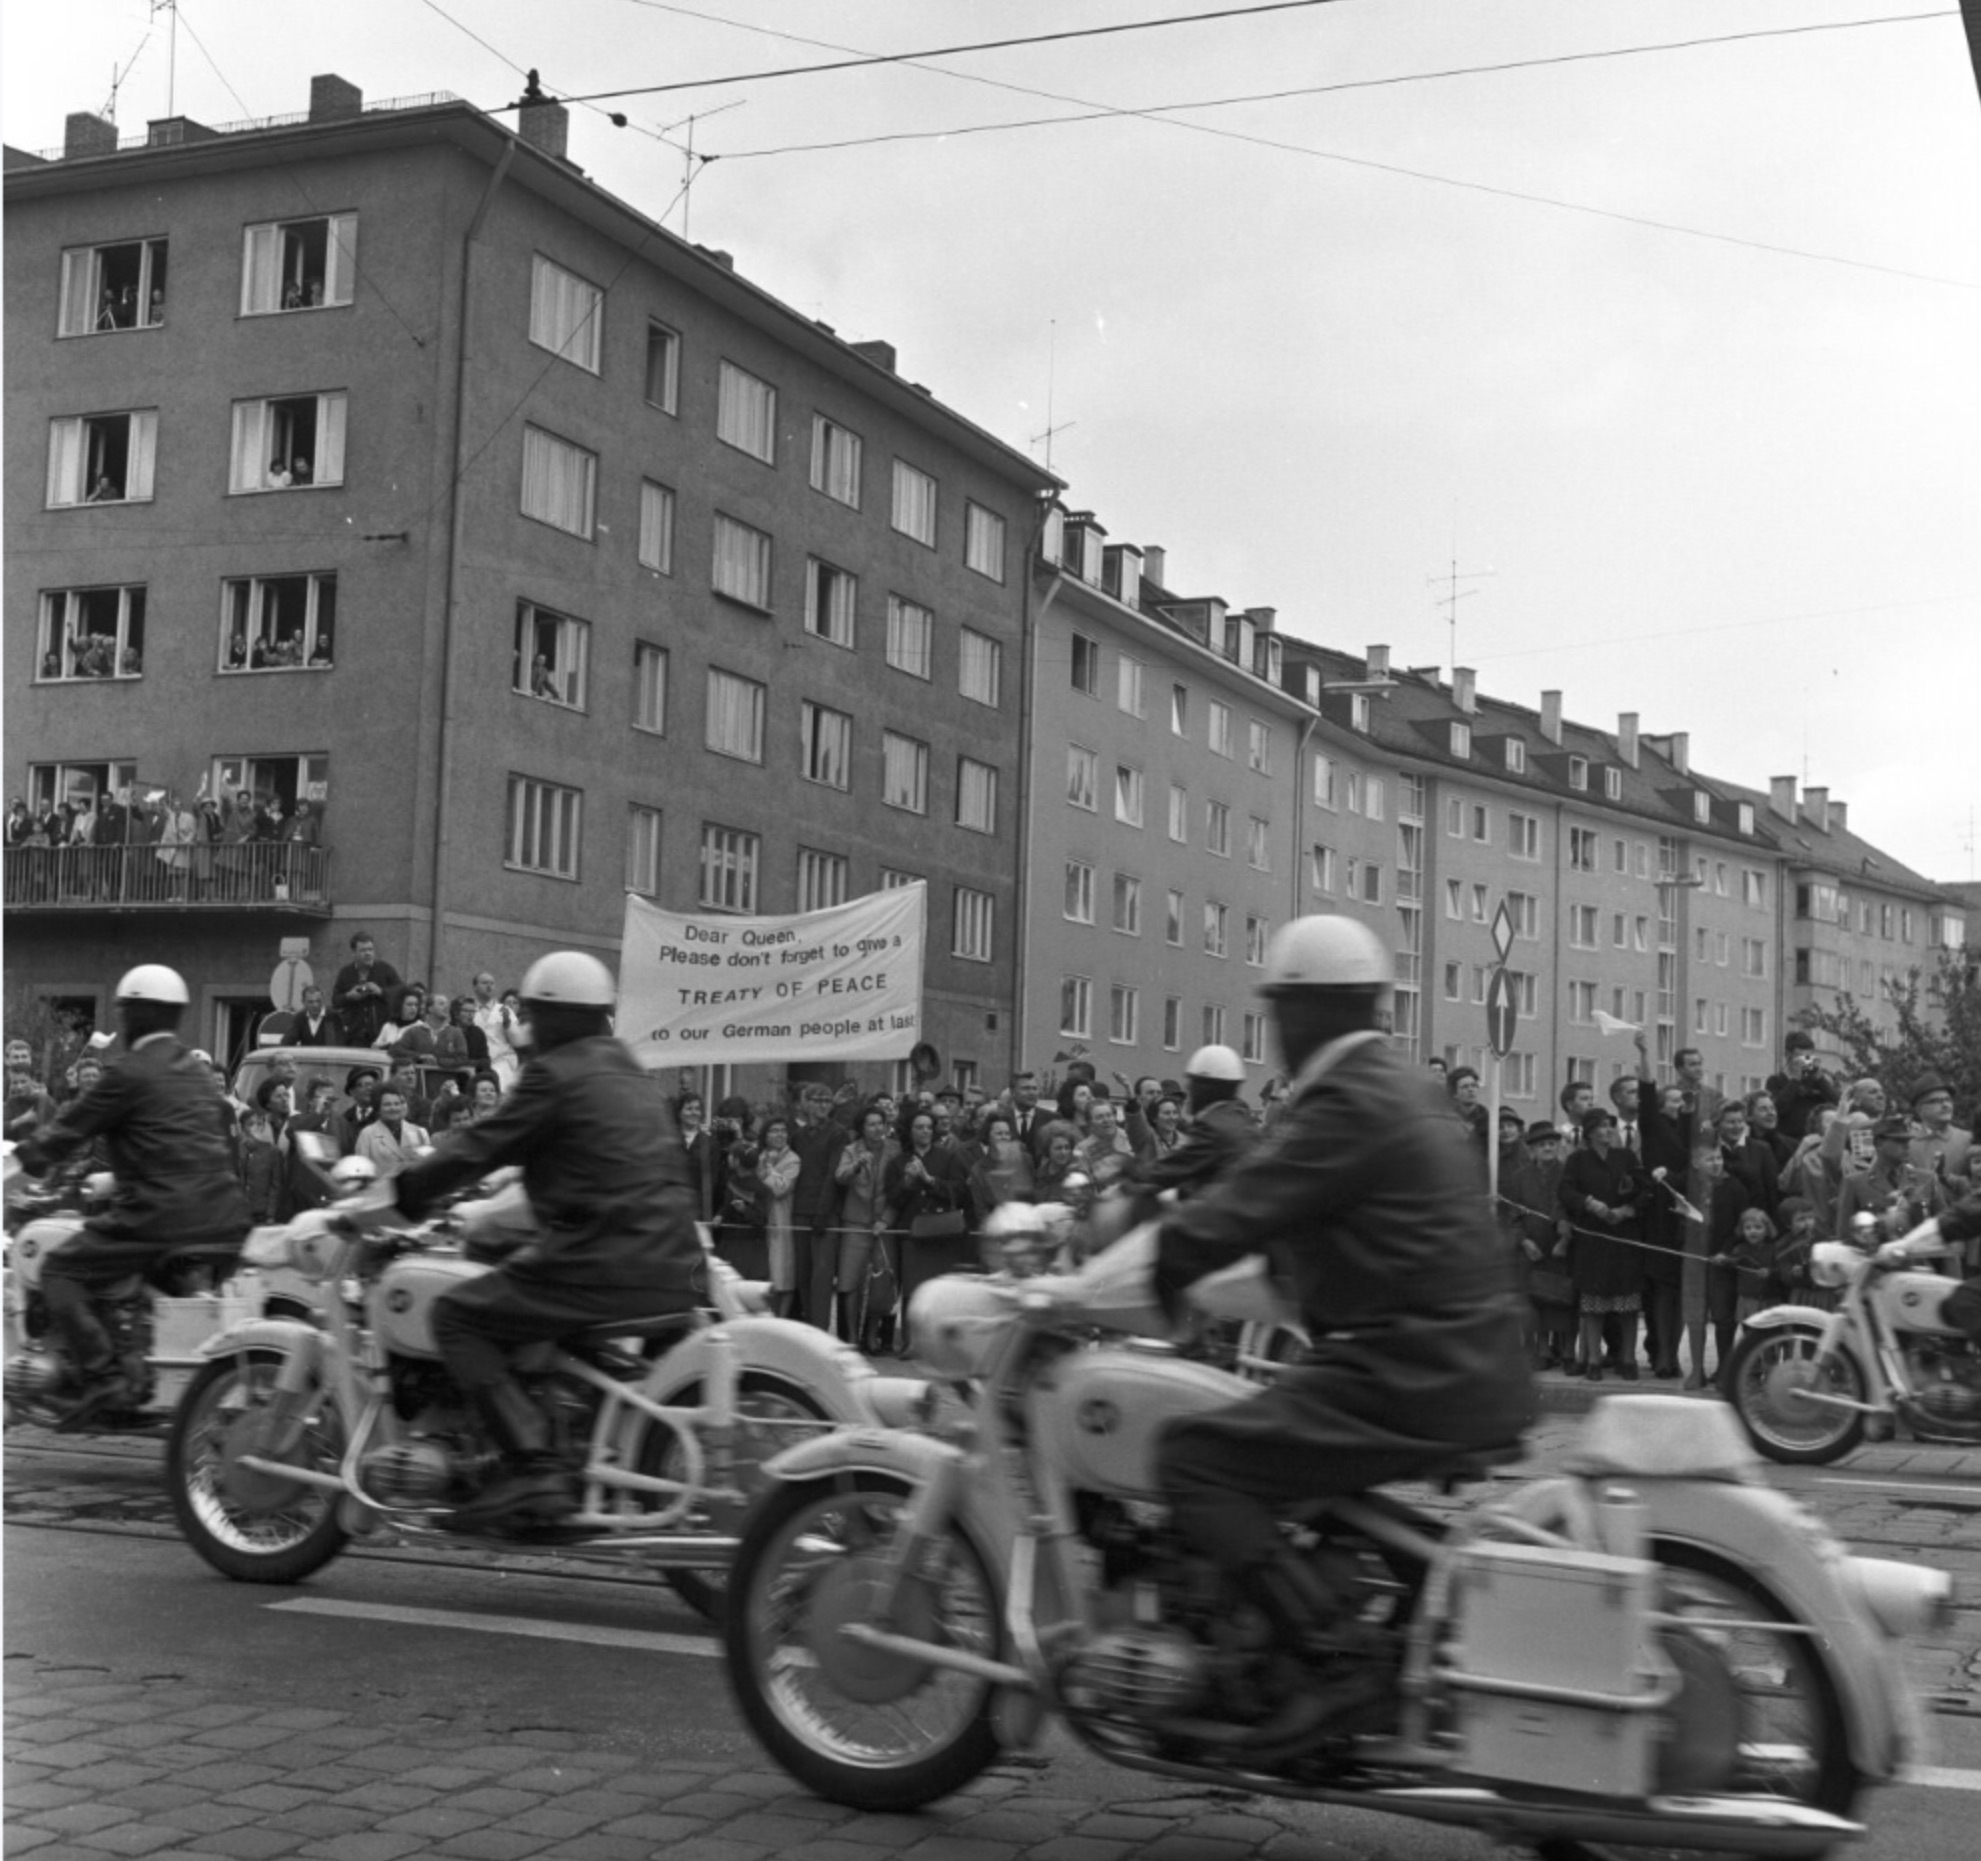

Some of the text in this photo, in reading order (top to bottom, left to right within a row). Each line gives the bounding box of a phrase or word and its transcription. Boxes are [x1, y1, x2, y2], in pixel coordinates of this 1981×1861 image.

[685, 925, 729, 944] Dear
[659, 935, 902, 967] Please don't forget to give a
[677, 973, 887, 1005] TREATY OF PEACE
[680, 1027, 710, 1041] our
[722, 1023, 792, 1039] German
[800, 1019, 861, 1039] people
[868, 1016, 884, 1032] at
[890, 1013, 914, 1030] last
